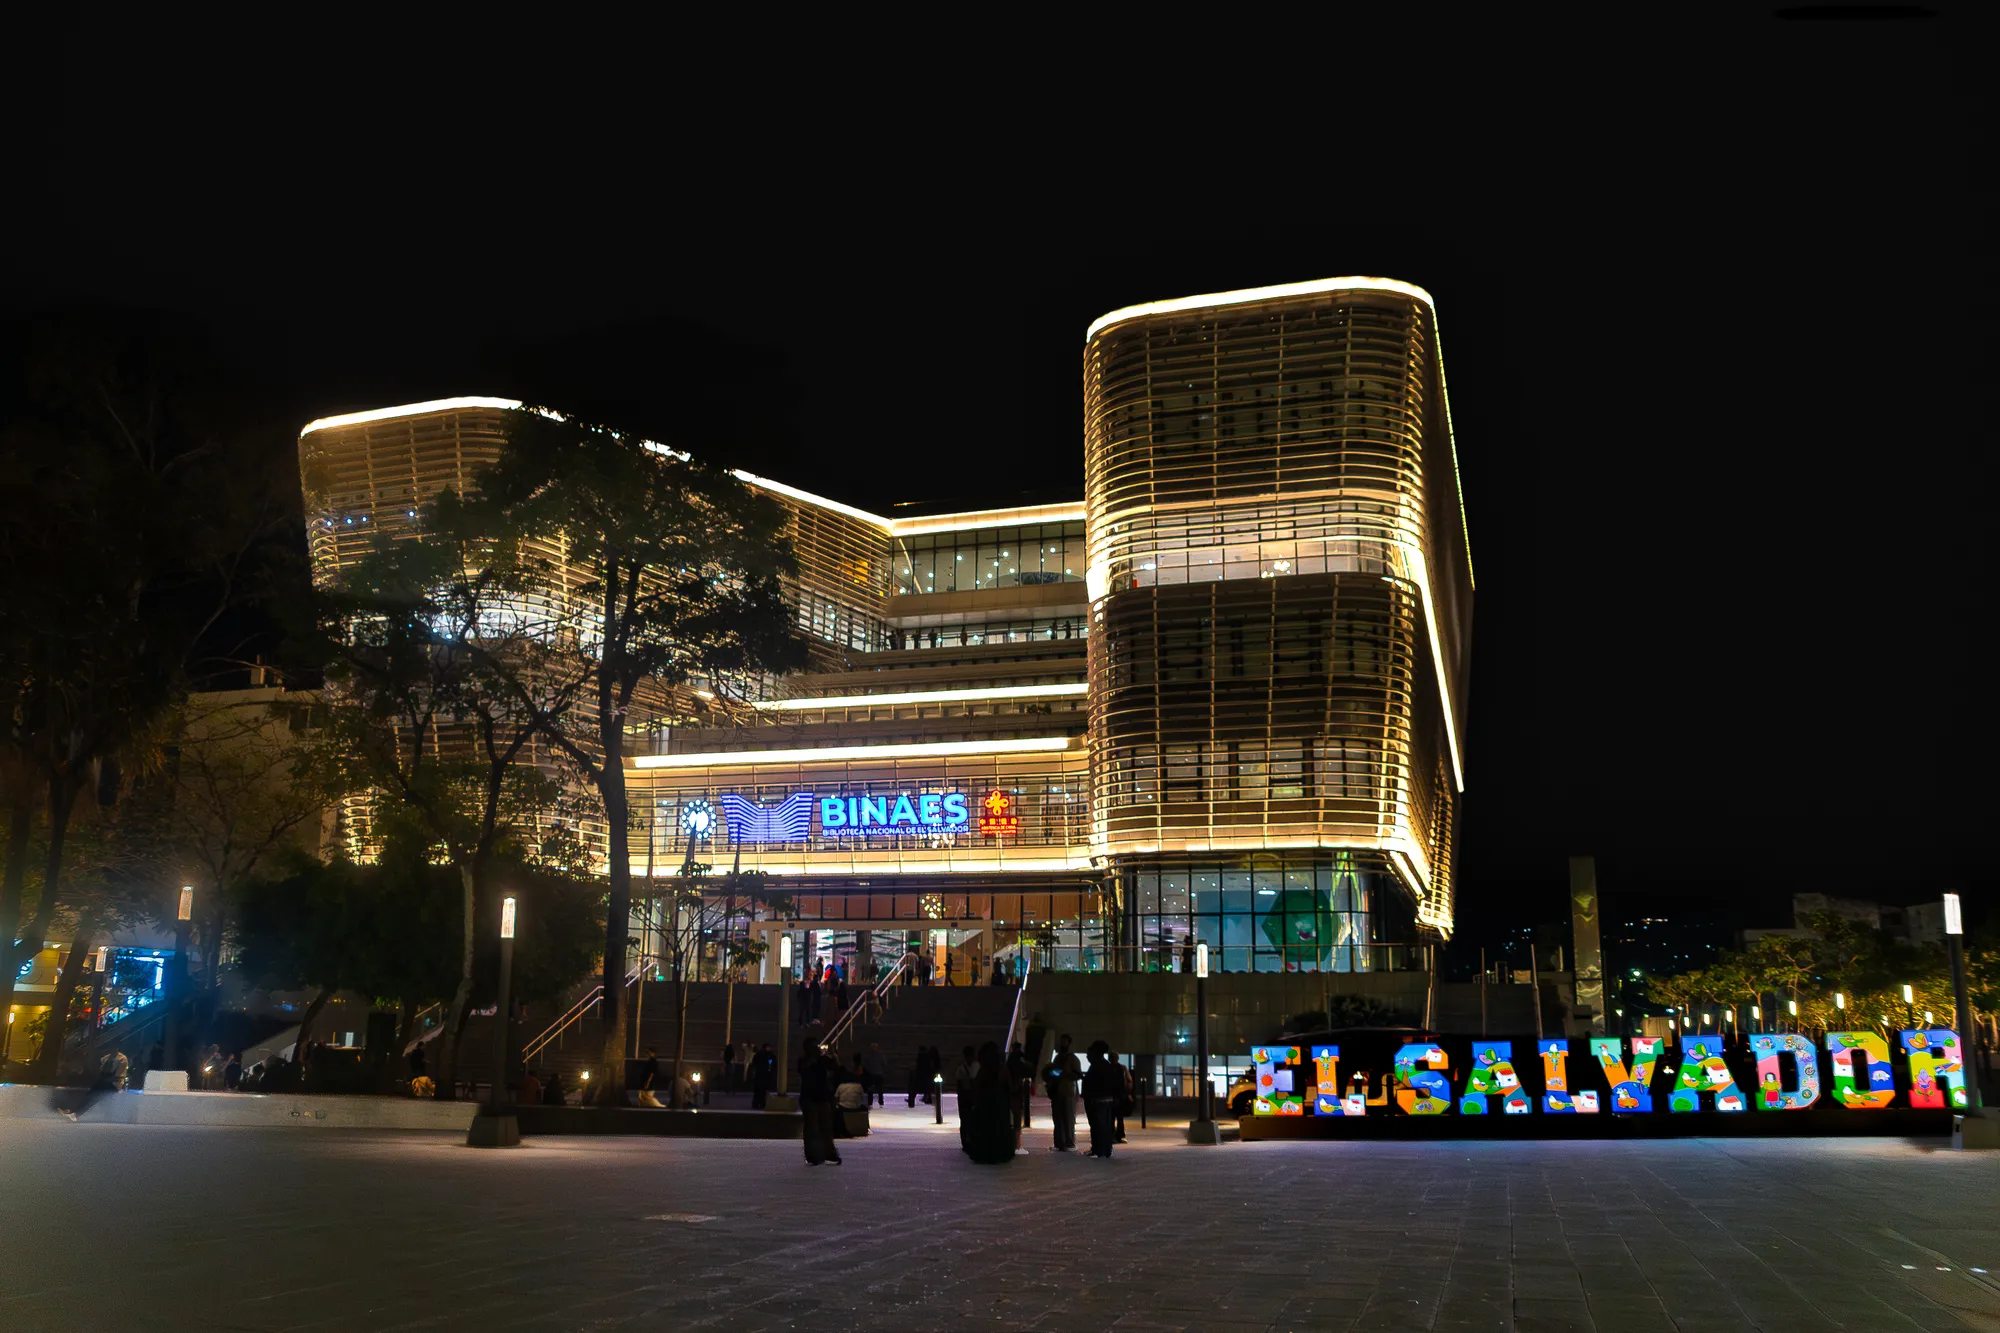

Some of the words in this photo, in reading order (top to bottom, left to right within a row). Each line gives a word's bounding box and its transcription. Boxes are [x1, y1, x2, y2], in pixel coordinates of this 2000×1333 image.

[821, 793, 969, 827] BINAES
[822, 828, 865, 837] BIBLIOTECA
[866, 827, 905, 836] NACIONAL
[905, 826, 917, 835] DE
[917, 826, 927, 834] EL
[927, 825, 969, 835] SALVADOR
[1251, 1045, 1367, 1117] EL
[1396, 1029, 1982, 1116] SALVADOR
